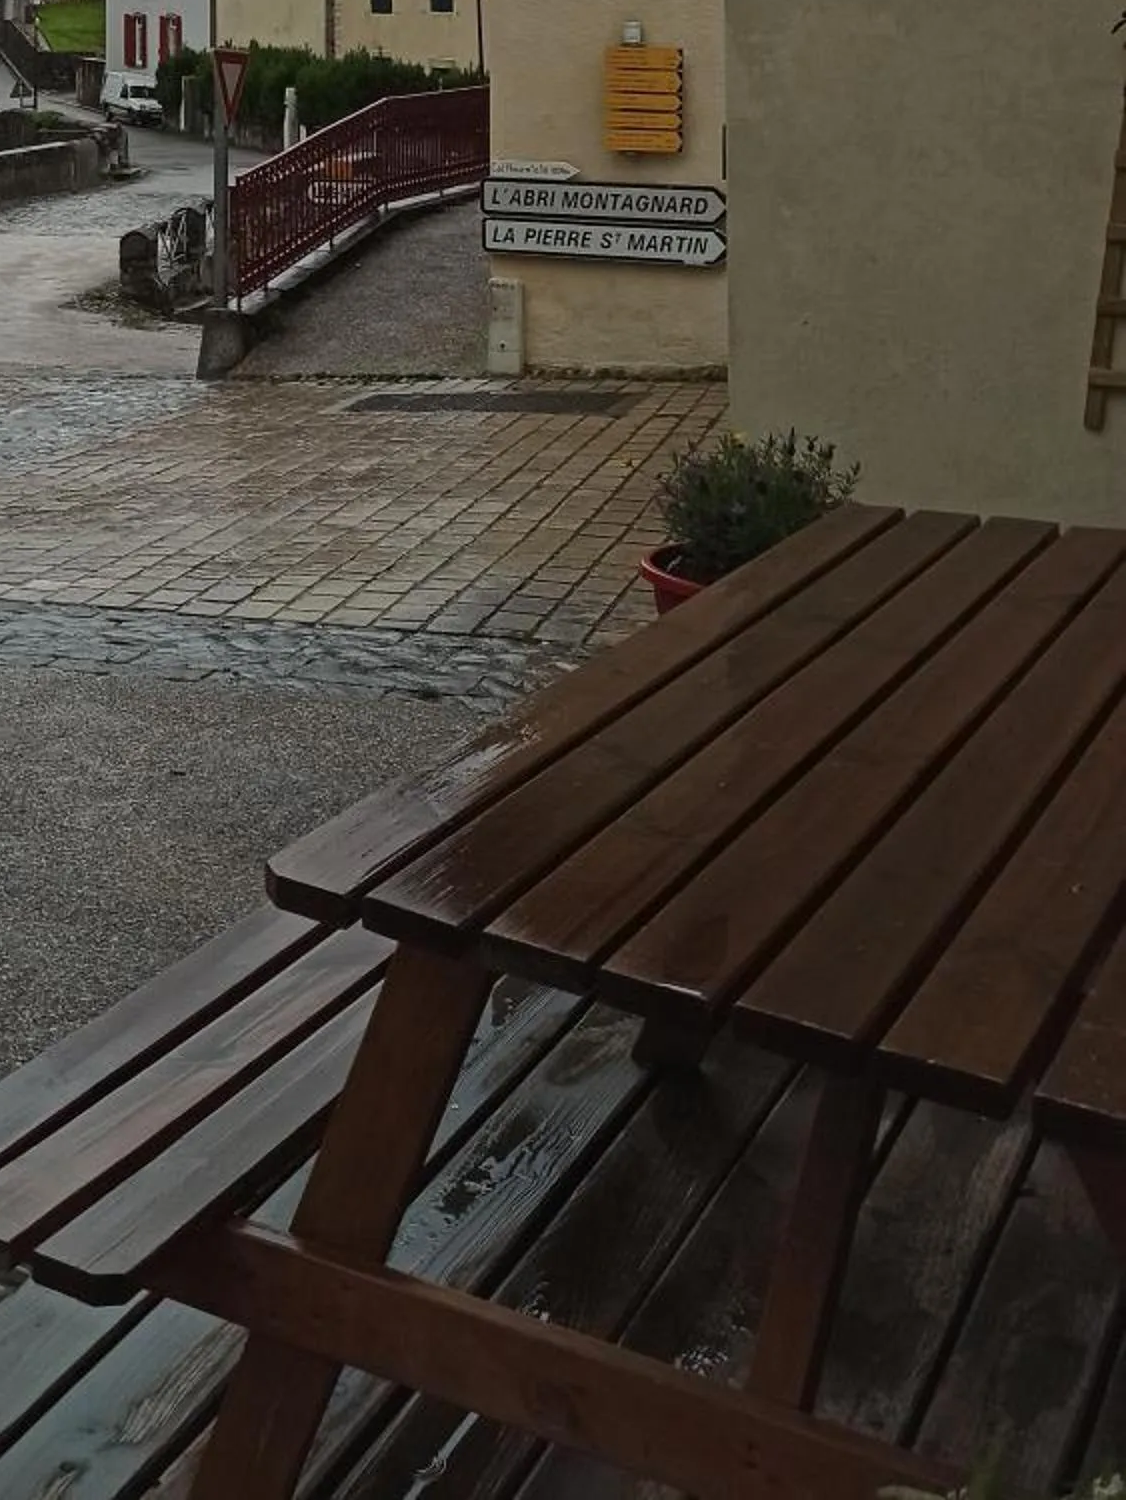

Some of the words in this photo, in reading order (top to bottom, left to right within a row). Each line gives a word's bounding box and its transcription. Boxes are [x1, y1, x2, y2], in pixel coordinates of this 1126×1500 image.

[491, 188, 555, 208] L'ABRI
[561, 191, 709, 216] MONTAGNARD
[492, 226, 515, 244] LA
[524, 228, 592, 249] PIERRE
[627, 234, 710, 255] MARTIN
